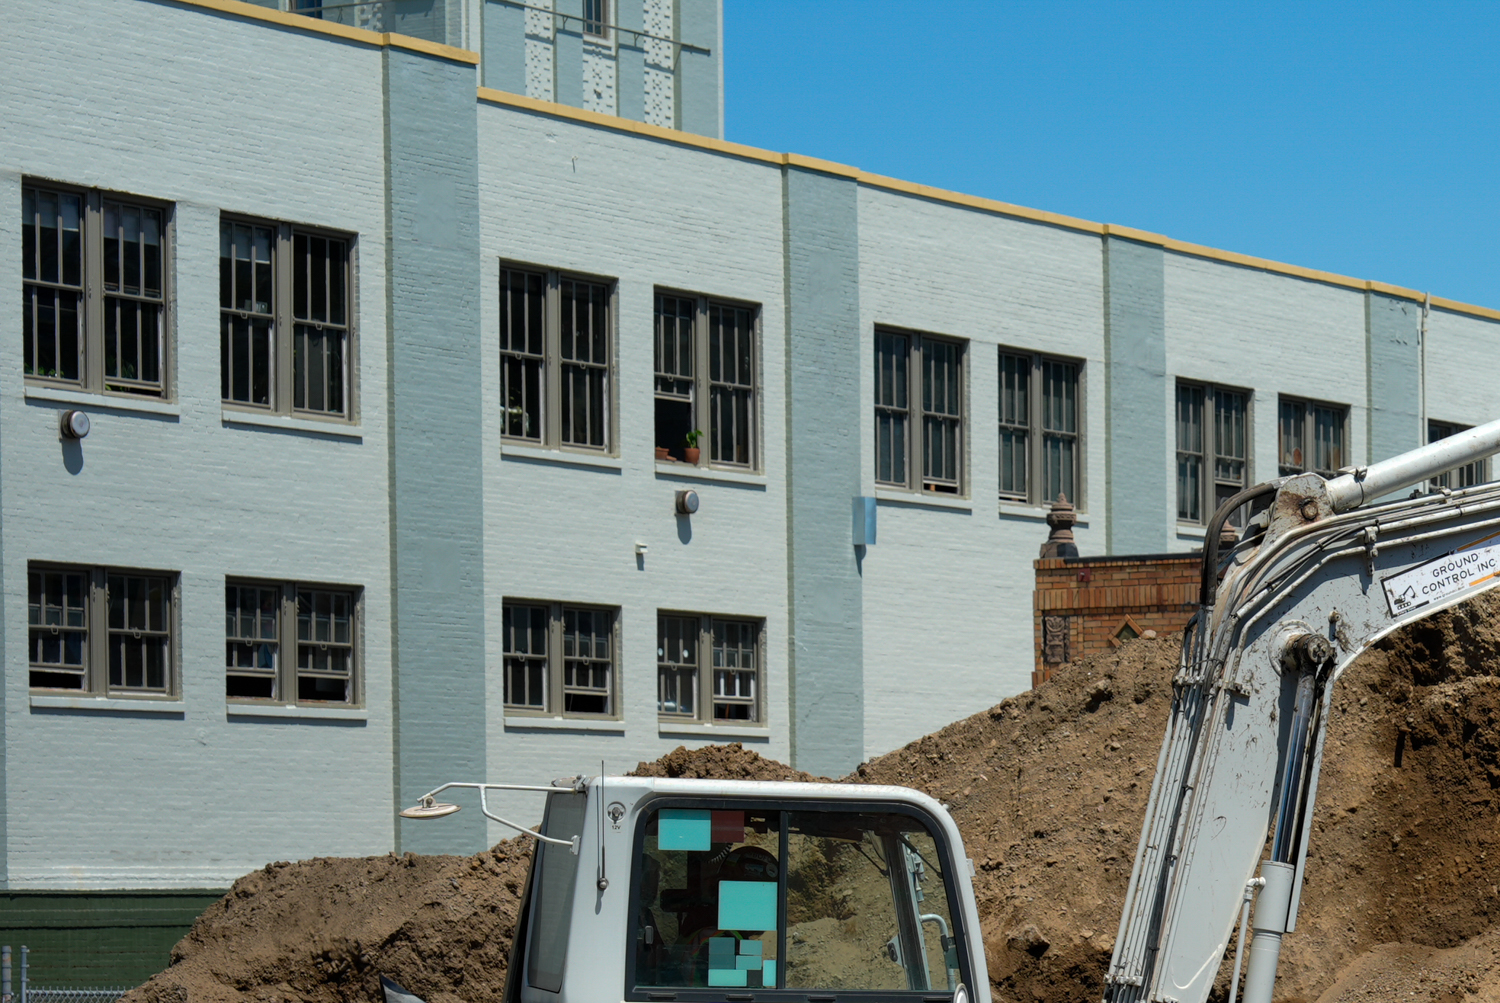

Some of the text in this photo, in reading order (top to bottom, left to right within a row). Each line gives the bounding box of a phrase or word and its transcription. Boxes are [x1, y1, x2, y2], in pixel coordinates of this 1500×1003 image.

[1421, 568, 1475, 595] CONTROL
[1477, 558, 1496, 572] INC
[1432, 552, 1479, 578] GROUND
